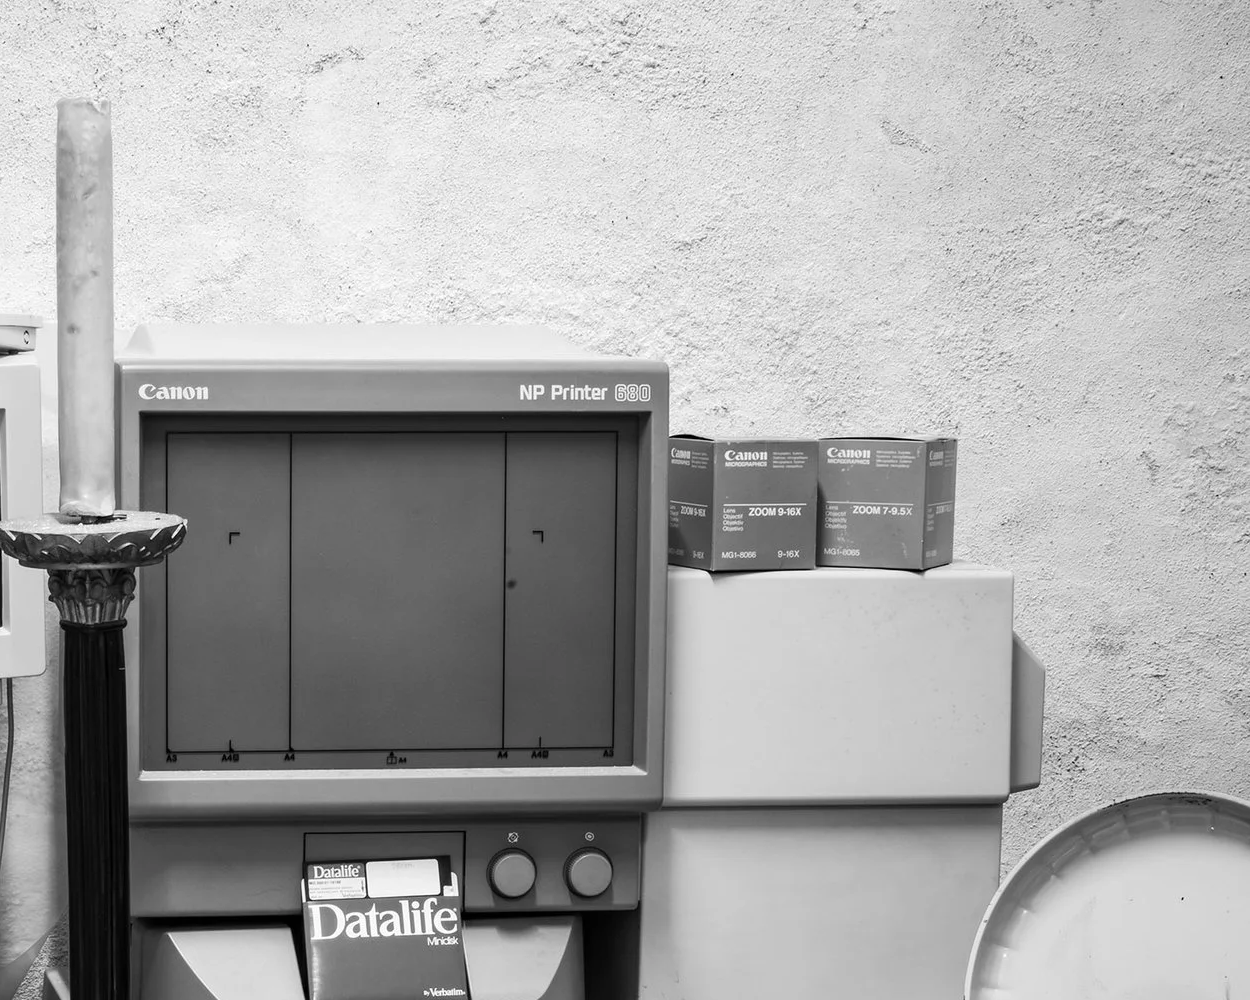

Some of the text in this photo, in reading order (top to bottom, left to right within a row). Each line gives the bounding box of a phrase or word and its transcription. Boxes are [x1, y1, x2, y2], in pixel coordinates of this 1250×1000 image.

[138, 383, 209, 400] Canon
[519, 383, 651, 402] NP Printer 680
[671, 447, 691, 459] Canon
[724, 450, 768, 461] Canon
[826, 447, 871, 459] Canon
[748, 507, 802, 517] ZOOM 9-16X
[852, 505, 913, 516] ZOOM 7-9.5X
[777, 550, 800, 558] 9-16X
[166, 752, 178, 763] A3
[284, 752, 296, 762] A4
[313, 864, 361, 879] Datalife
[308, 898, 458, 940] Datalife
[427, 936, 459, 946] Minidisk
